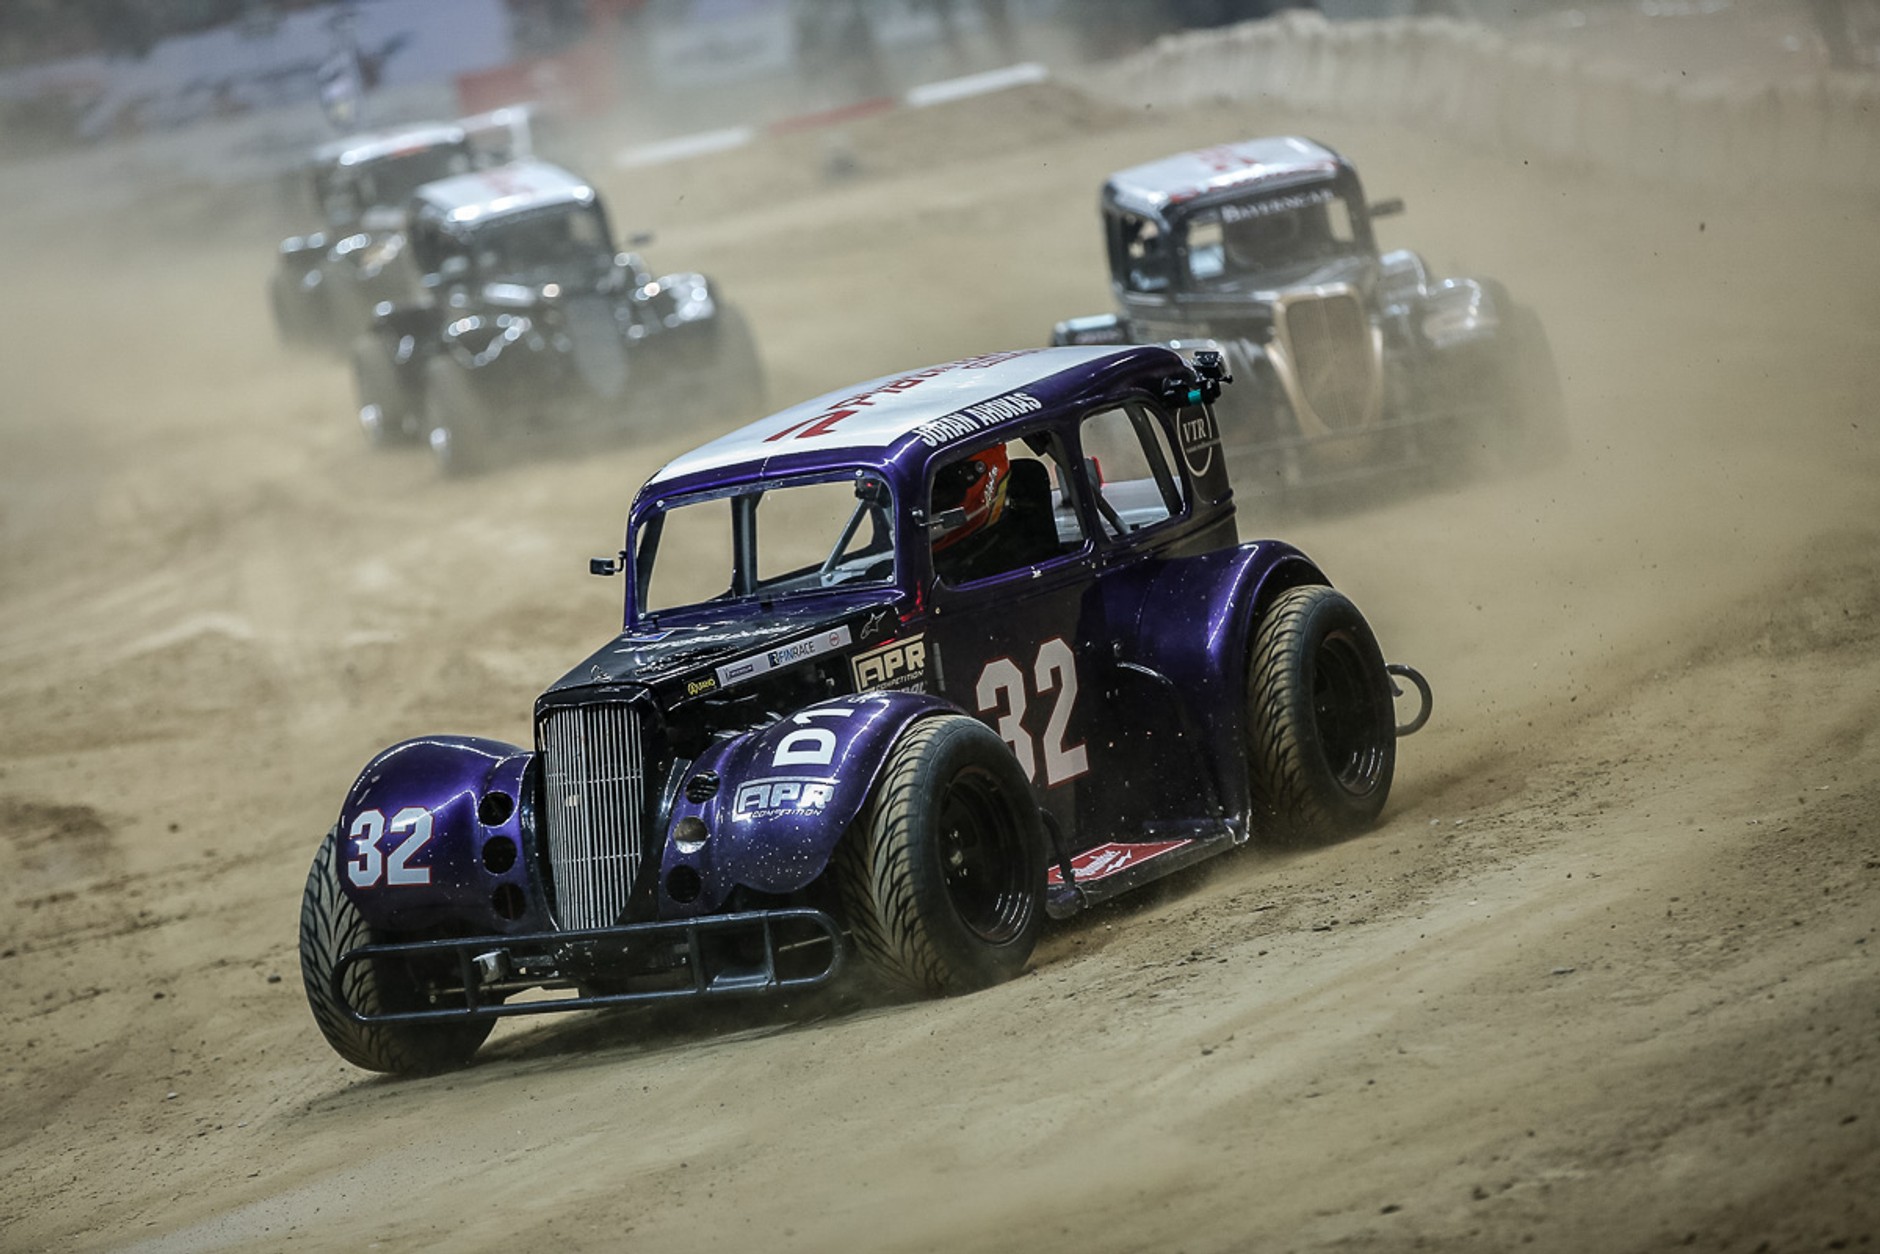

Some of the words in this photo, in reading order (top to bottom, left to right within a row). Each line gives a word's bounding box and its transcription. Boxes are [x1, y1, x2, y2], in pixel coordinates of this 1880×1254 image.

[857, 641, 926, 689] APR
[976, 636, 1089, 788] 32
[738, 782, 834, 814] APR
[347, 806, 434, 890] 32
